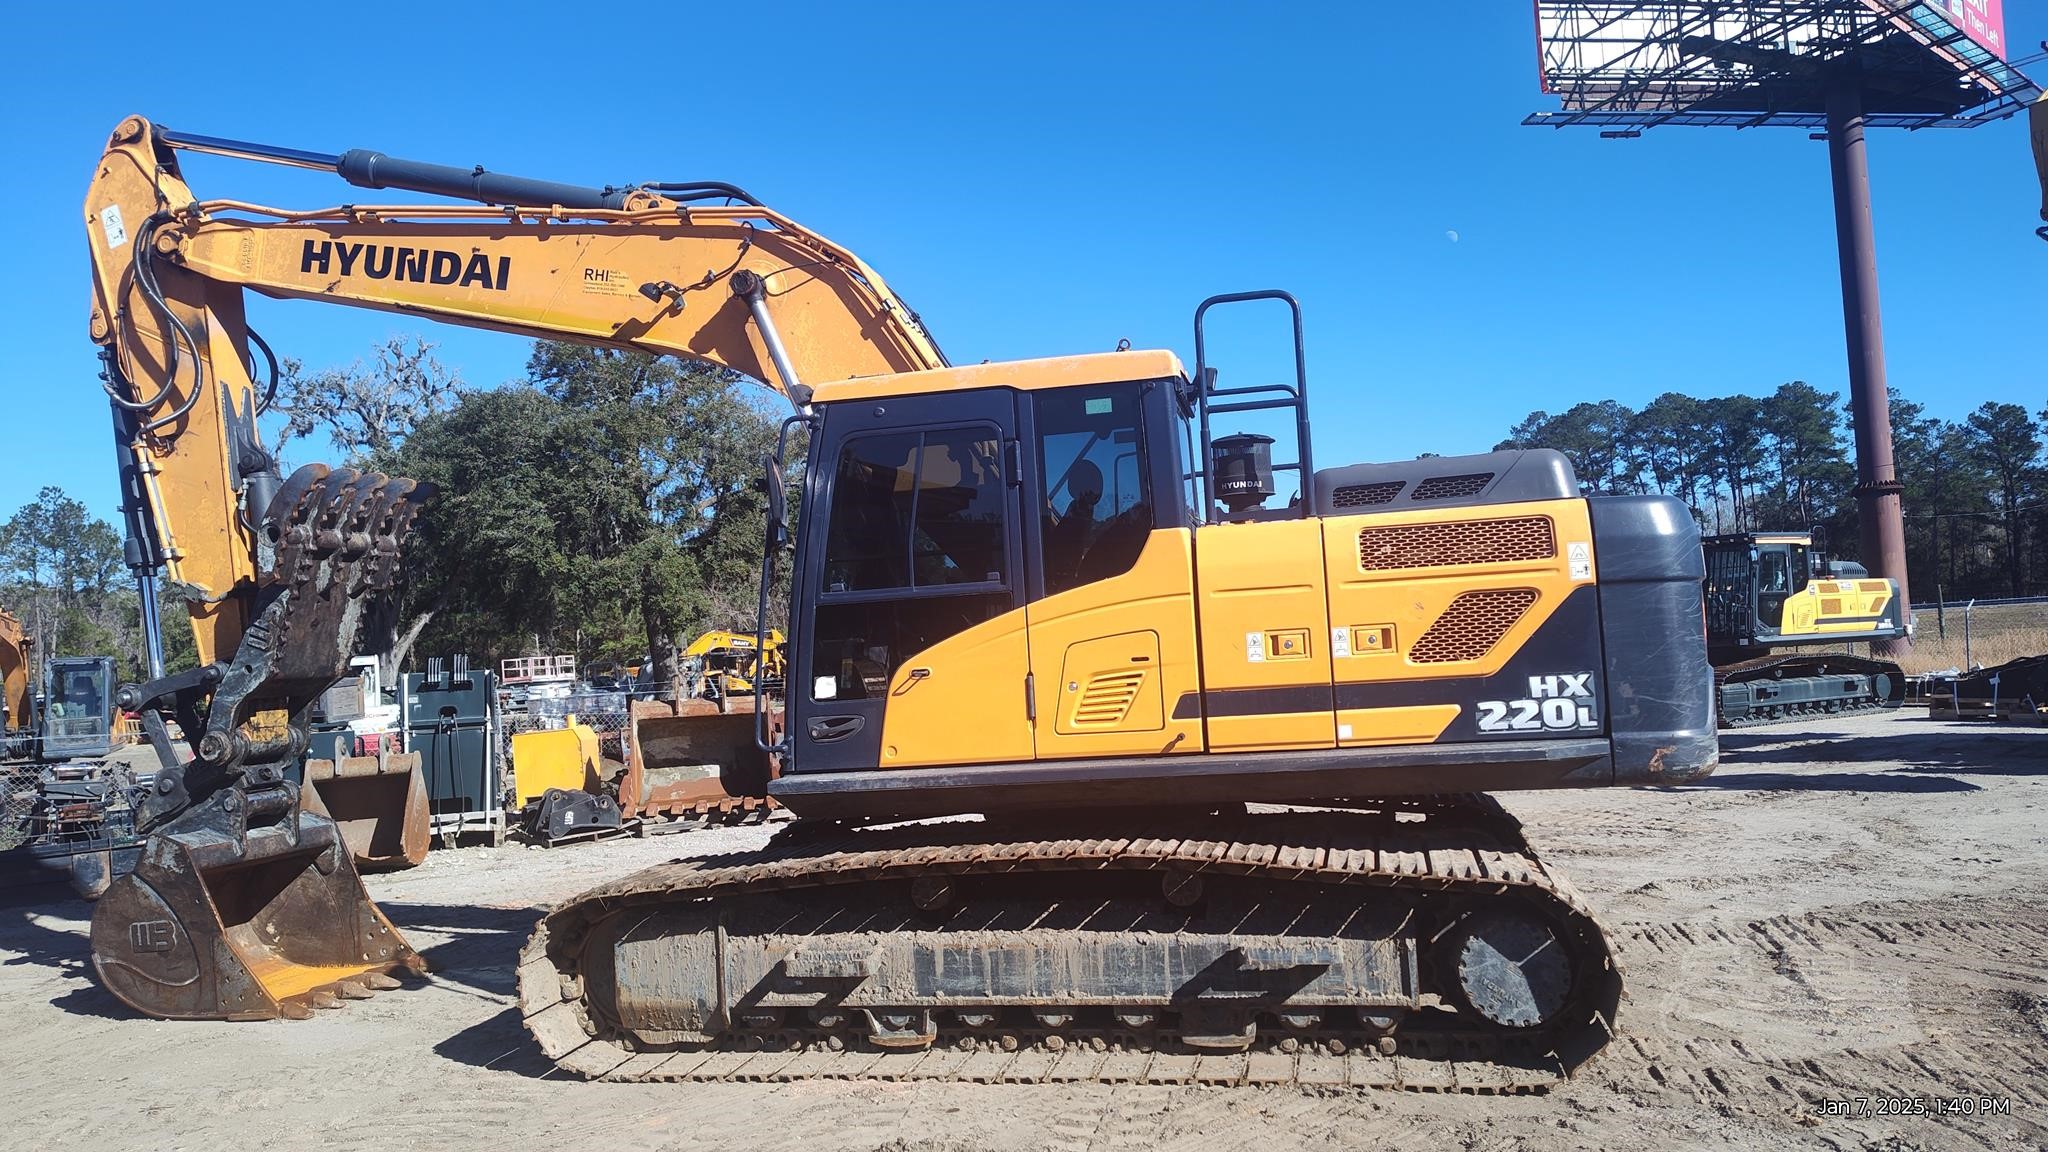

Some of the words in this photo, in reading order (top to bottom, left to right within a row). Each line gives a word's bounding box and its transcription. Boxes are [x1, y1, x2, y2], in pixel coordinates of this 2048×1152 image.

[1966, 6, 1985, 36] Then
[1985, 23, 1999, 48] Left
[301, 240, 511, 291] HYUNDAI
[584, 268, 609, 282] RHI
[1222, 480, 1262, 489] HYUNDAI
[1529, 673, 1591, 698] HX
[1477, 699, 1598, 731] 220L
